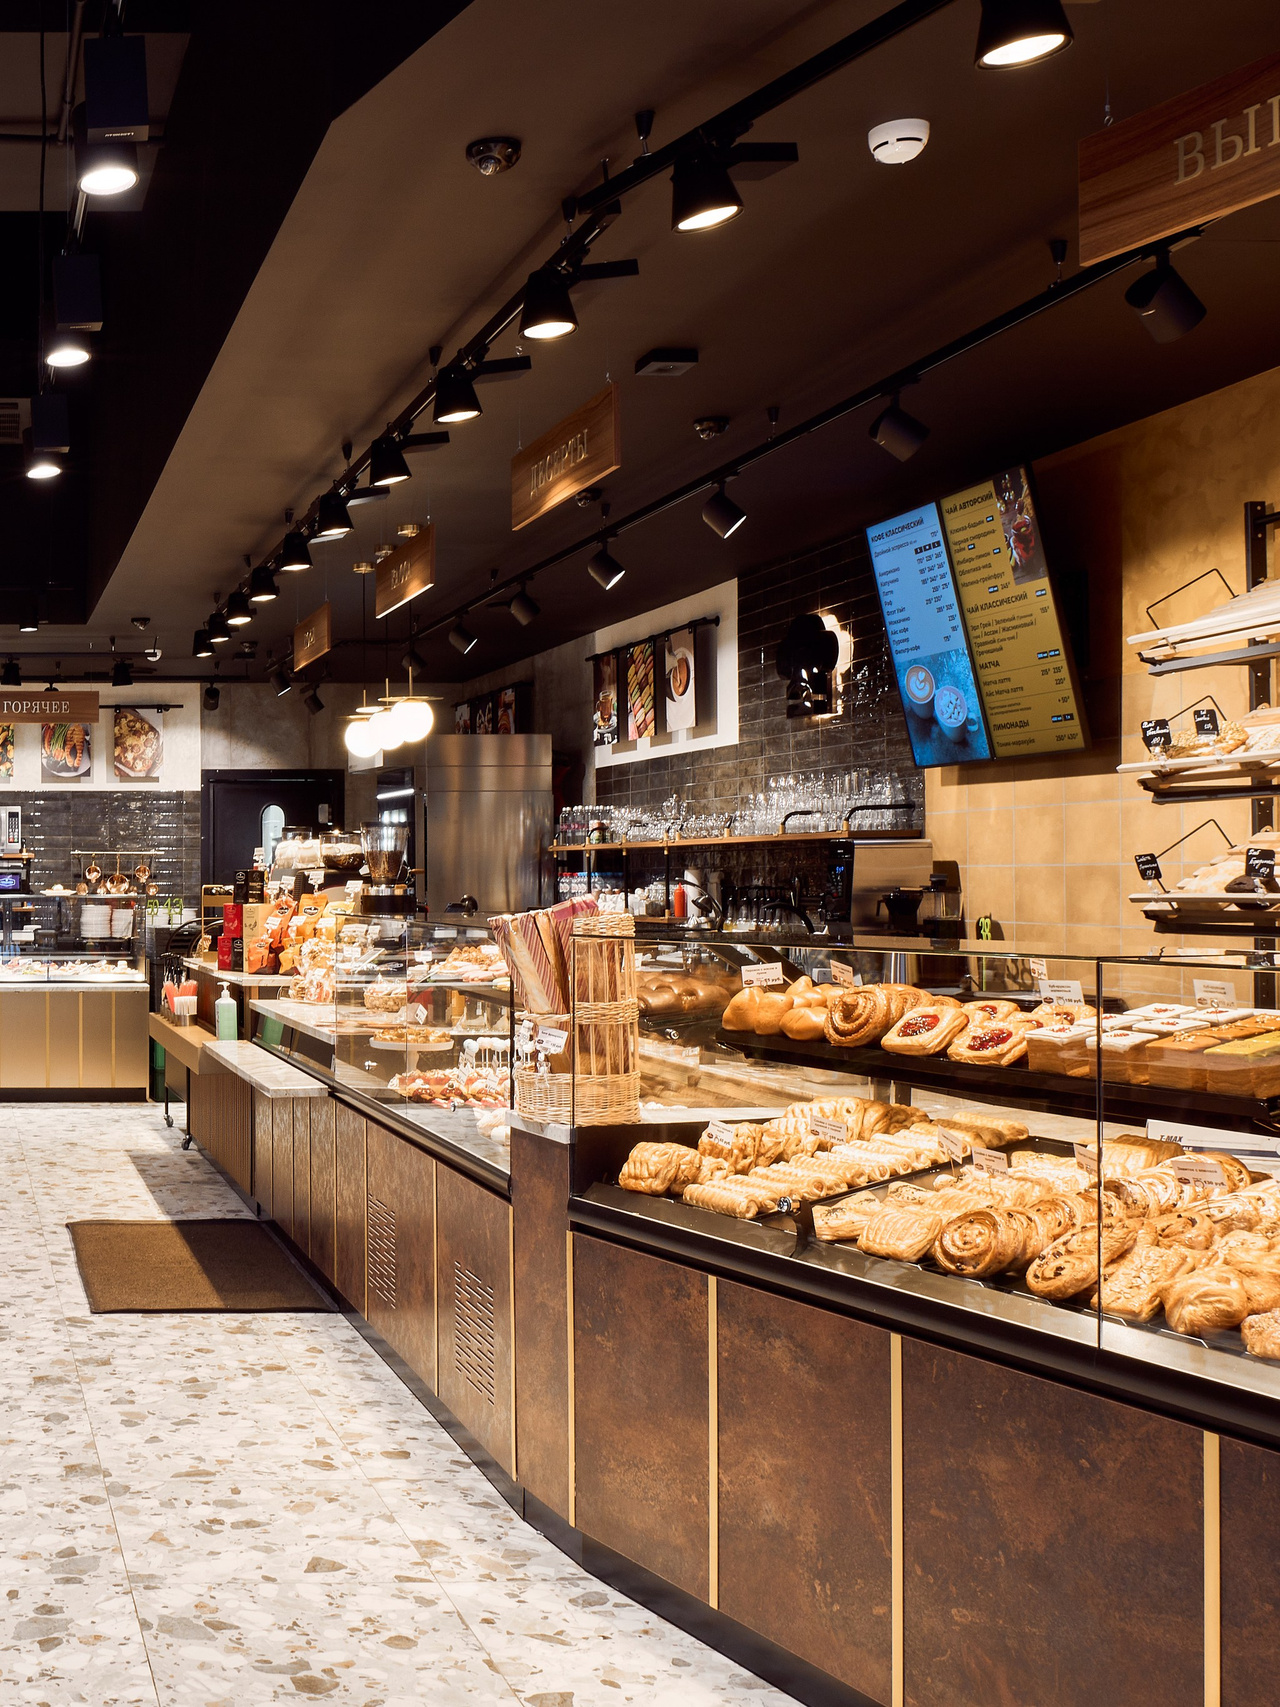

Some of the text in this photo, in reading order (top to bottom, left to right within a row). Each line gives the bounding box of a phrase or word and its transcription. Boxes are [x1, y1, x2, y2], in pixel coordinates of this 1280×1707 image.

[530, 428, 588, 500] ДЕСЕРТЫ
[945, 490, 993, 515] ЧАЙ АВТОРСКИЙ
[871, 517, 924, 542] КОФЕ КЛАССИЧЕСКИЙ
[966, 604, 979, 614] ЧАЙ
[980, 591, 1027, 610] КЛАССИЧЕСКИЙ
[894, 644, 920, 654] Фильтр-кофе
[976, 645, 1003, 655] Гречишный
[979, 660, 1000, 669] МАТЧА
[2, 700, 70, 714] ГОРЯЧЕЕ
[993, 720, 1029, 731] ЛИМОНАДЫ
